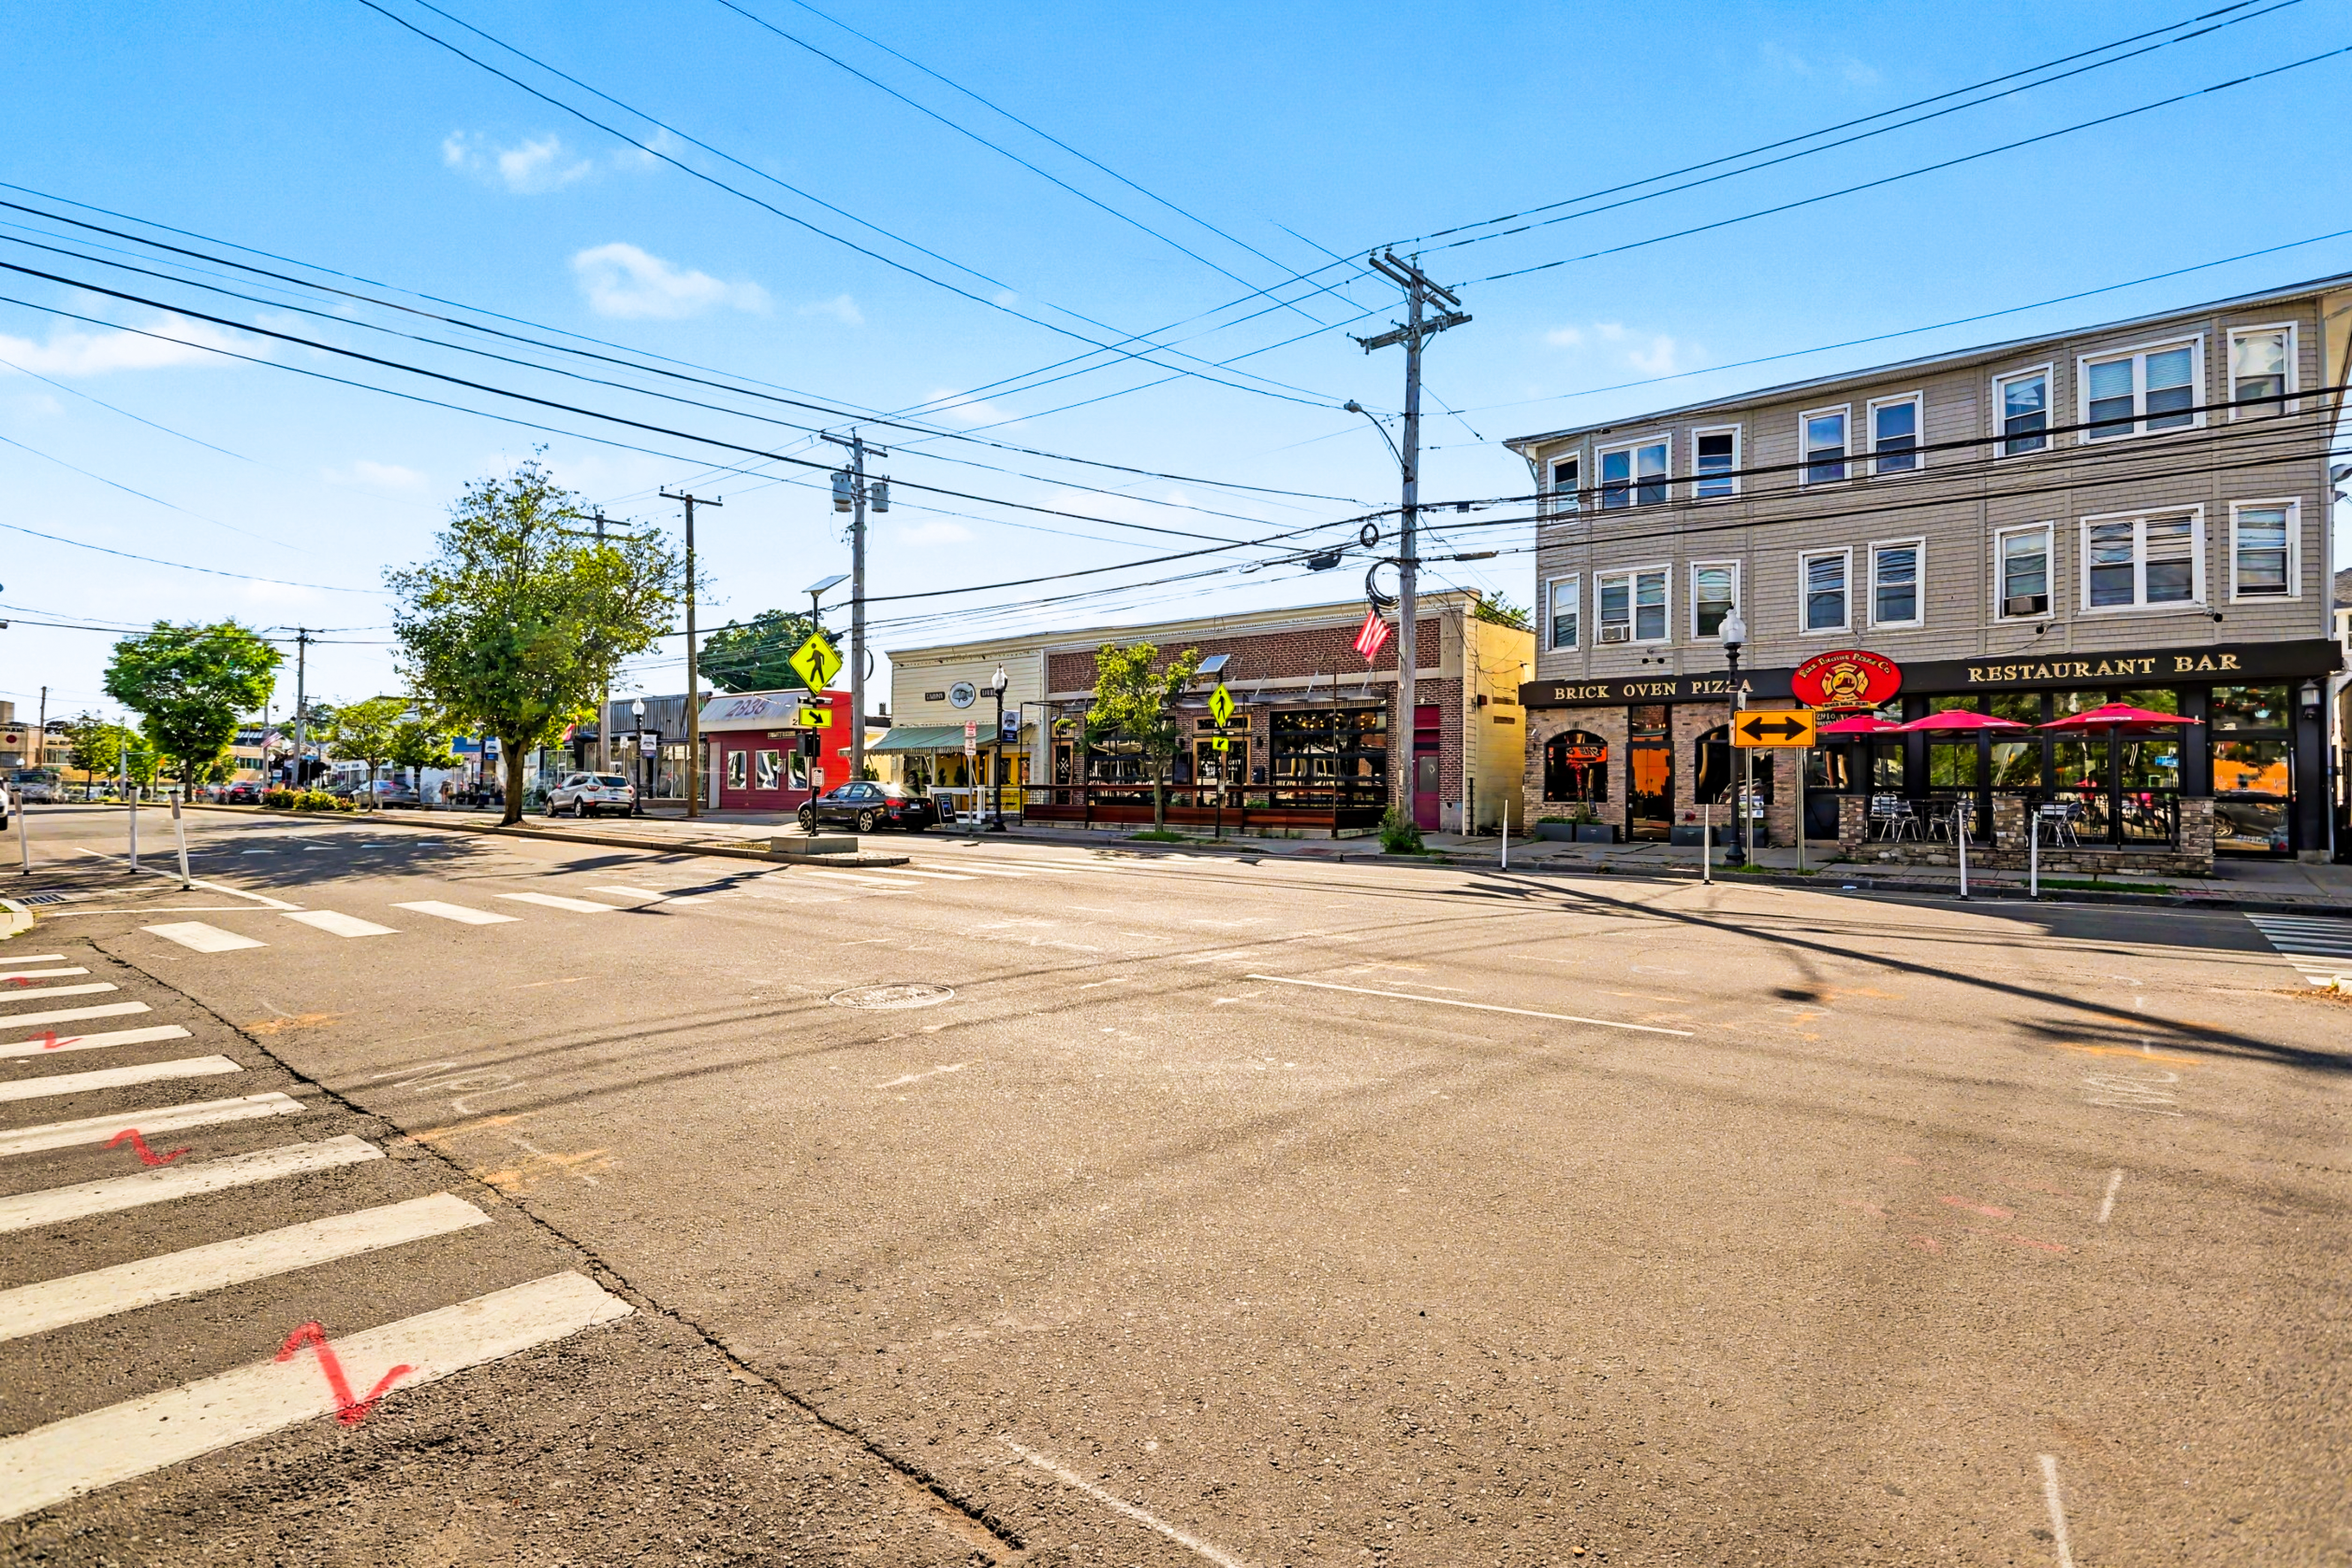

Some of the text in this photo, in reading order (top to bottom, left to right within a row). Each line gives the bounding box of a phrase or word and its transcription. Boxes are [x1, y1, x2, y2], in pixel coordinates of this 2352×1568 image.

[1968, 654, 2241, 682] RESTAURANT BAR
[1554, 686, 1610, 699] BRICK
[1623, 682, 1677, 697] OVEN
